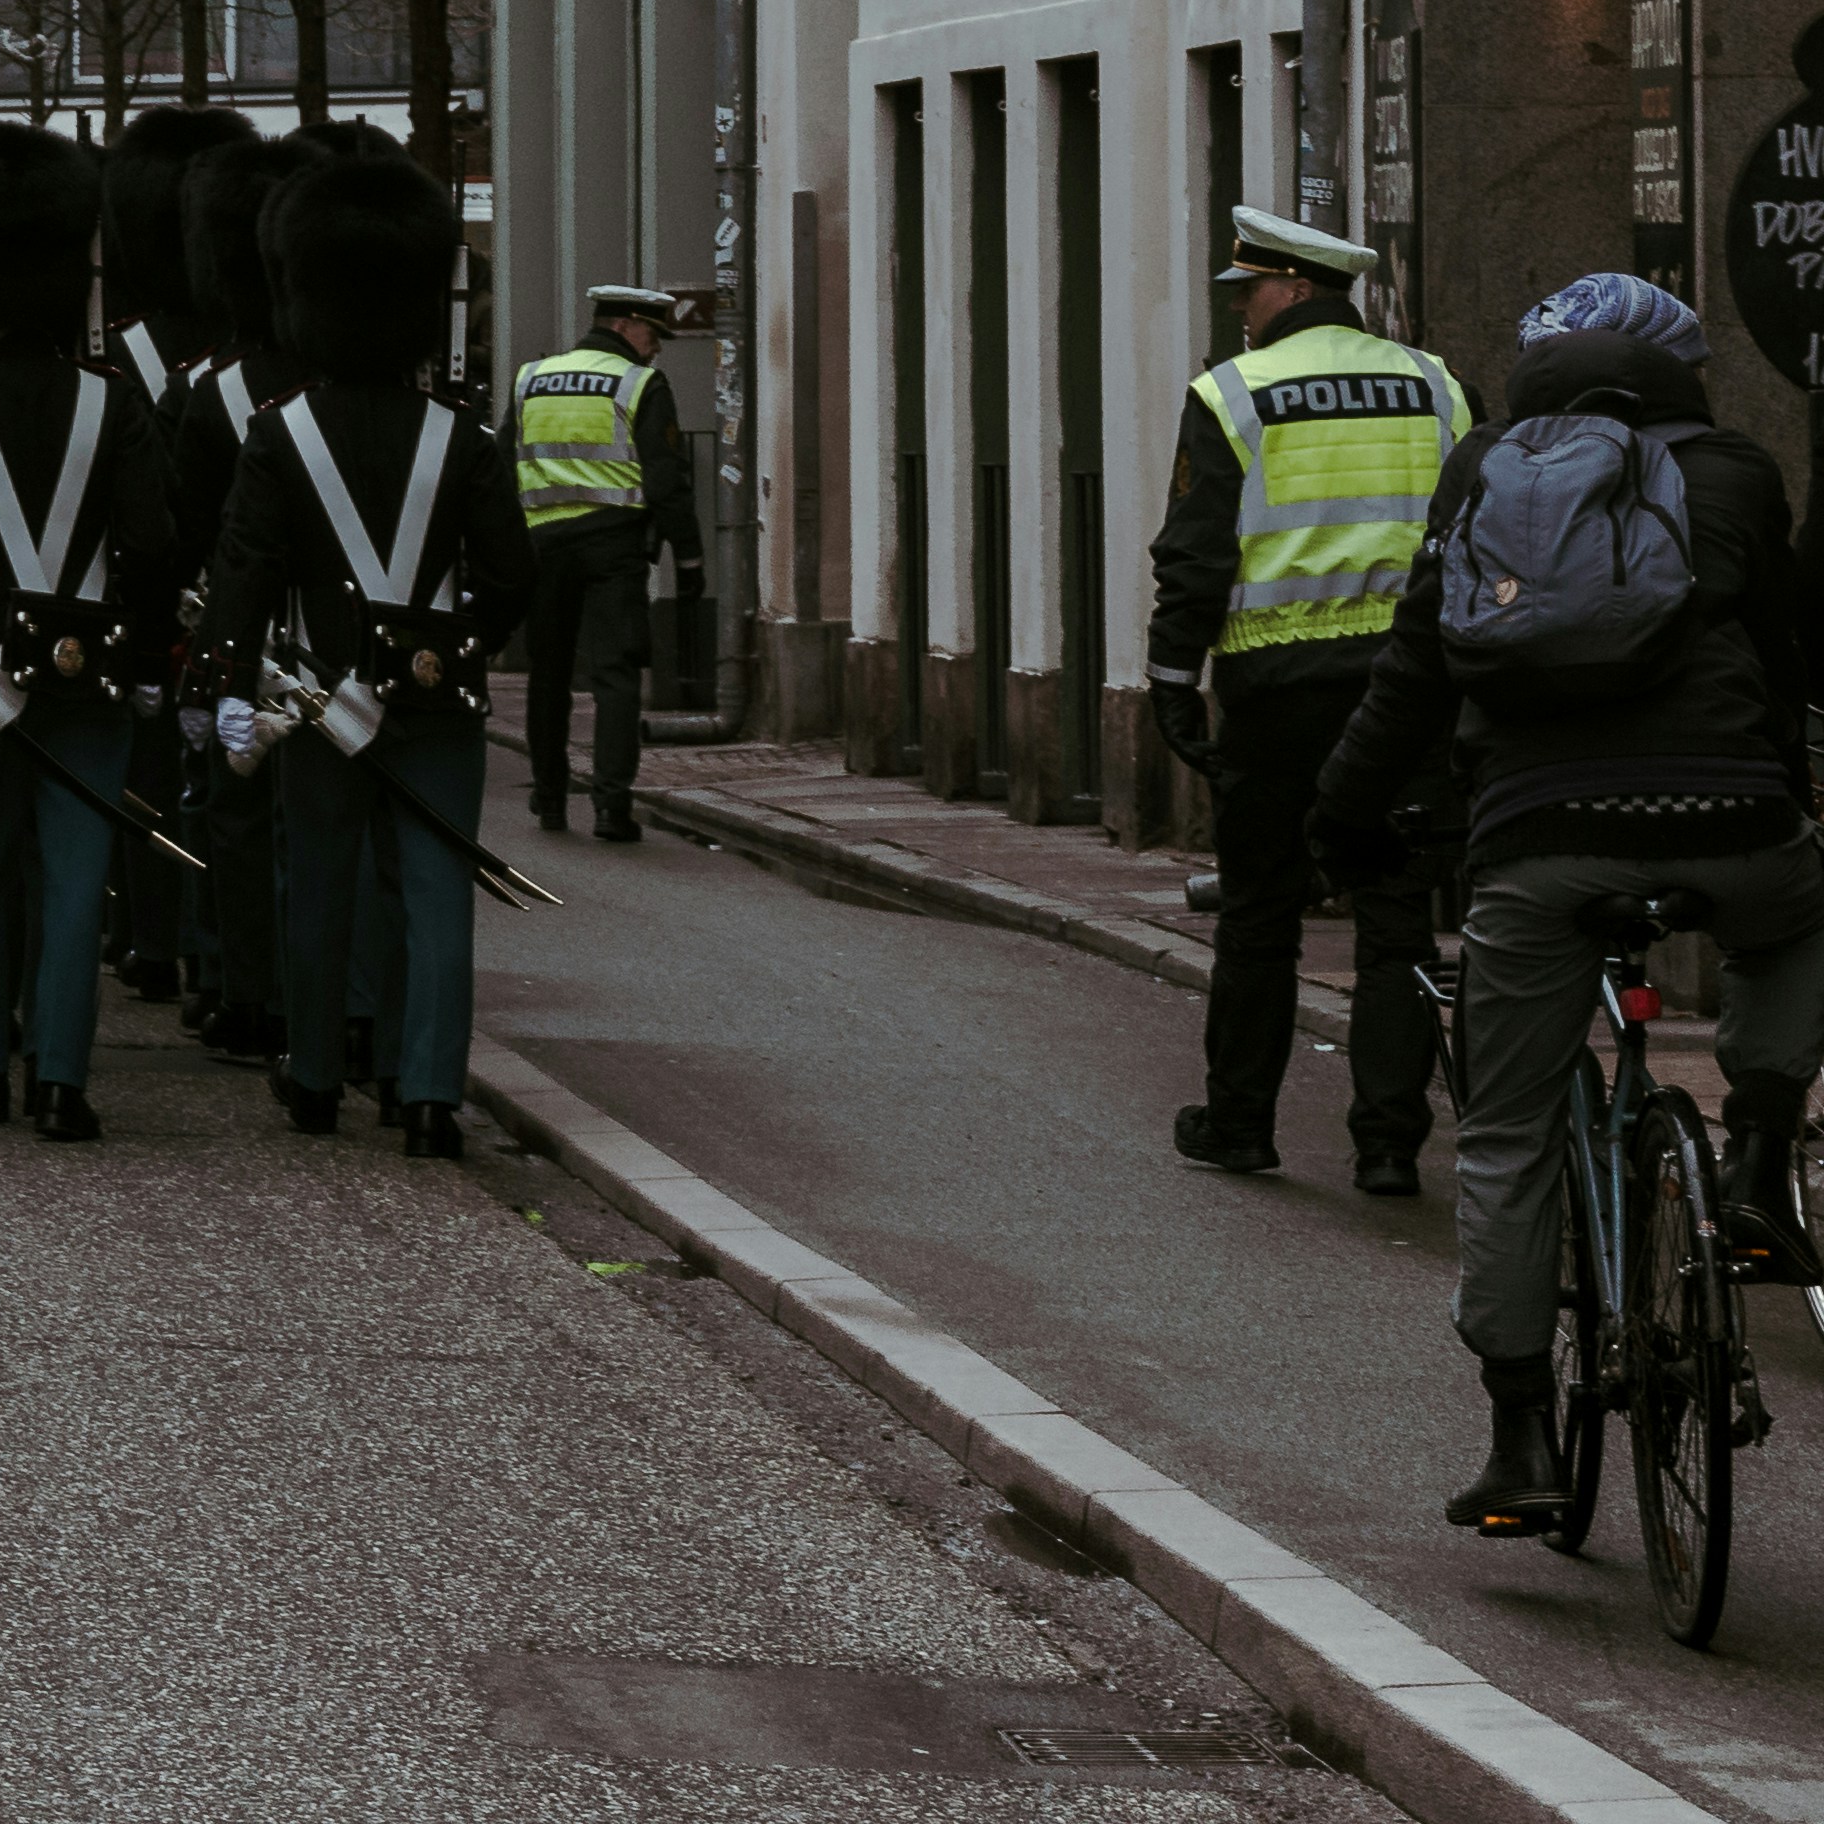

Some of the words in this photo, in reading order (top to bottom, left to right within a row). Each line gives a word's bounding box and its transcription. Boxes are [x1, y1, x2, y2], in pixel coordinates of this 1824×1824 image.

[1777, 123, 1824, 178] HV
[530, 373, 614, 393] POLITI
[1269, 378, 1422, 415] POLITI
